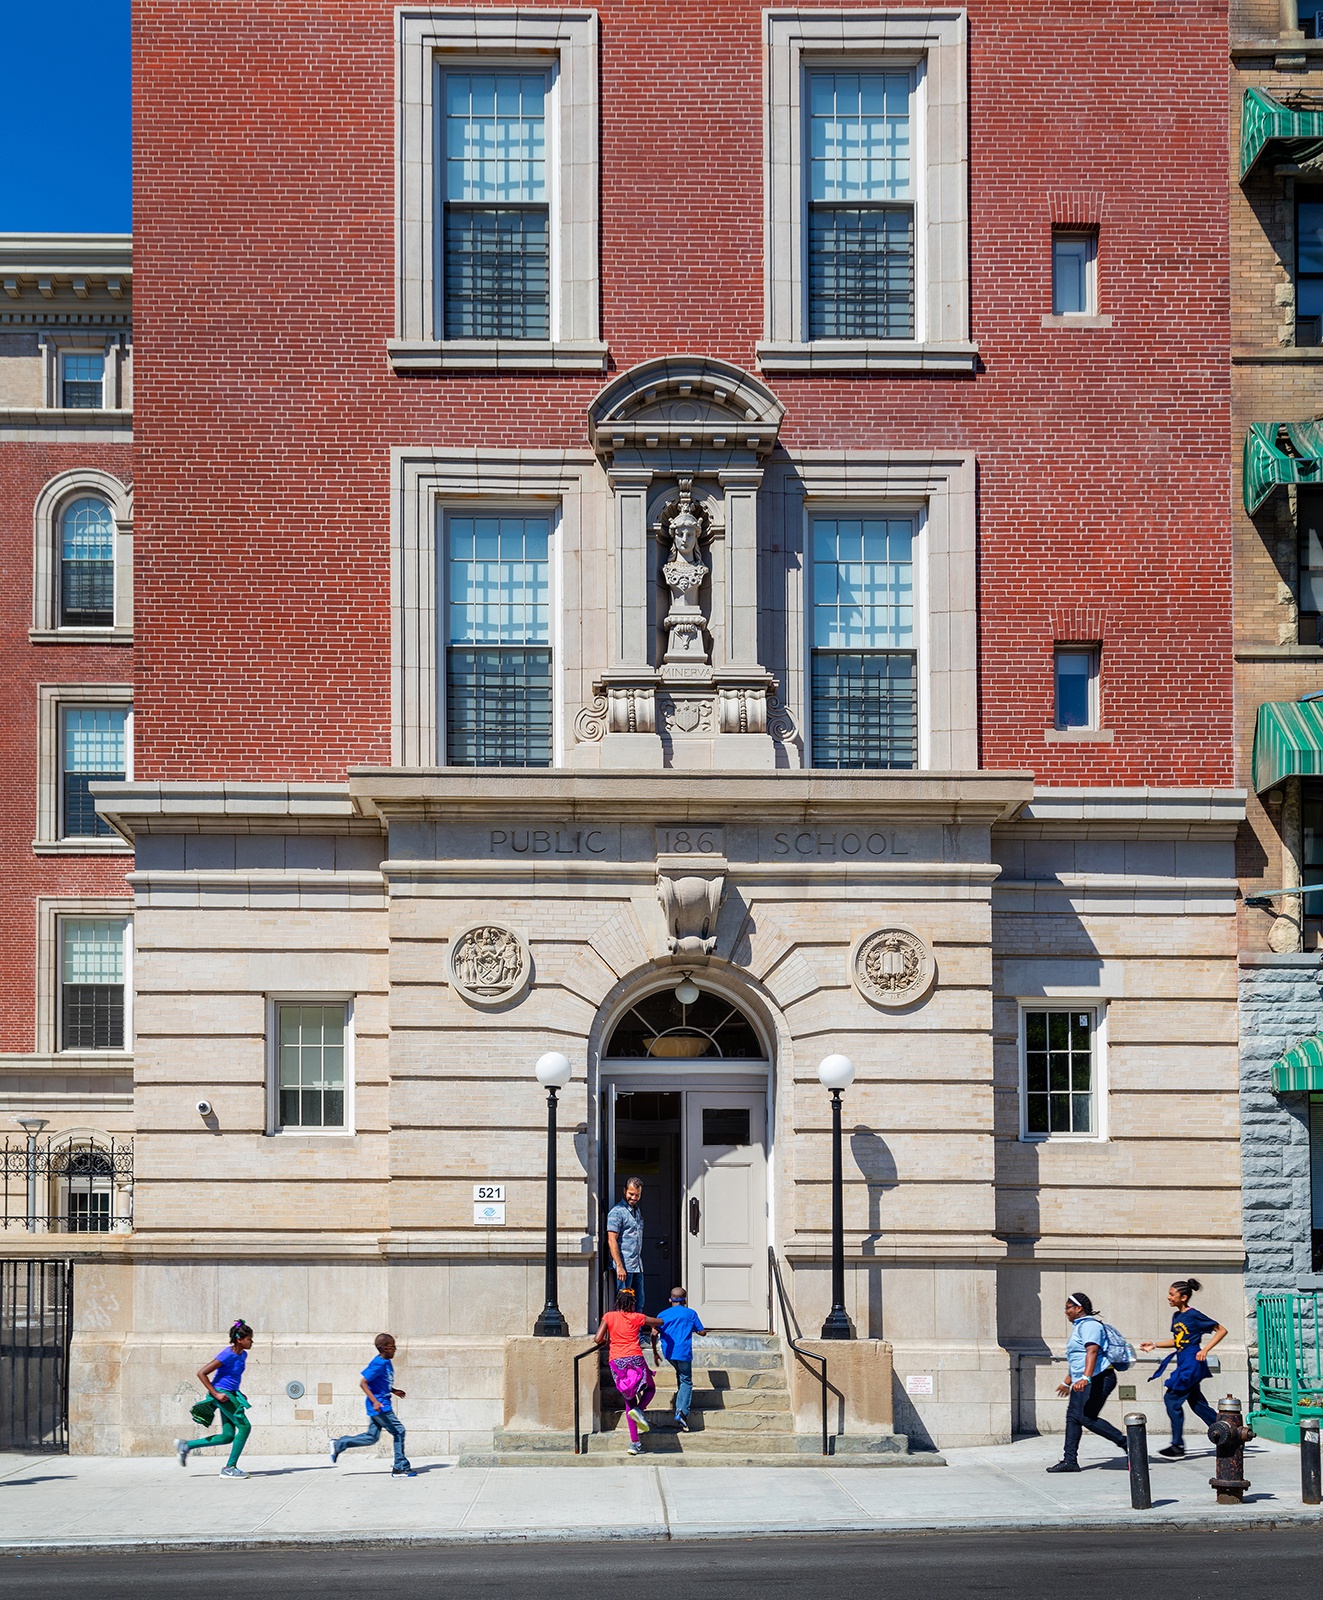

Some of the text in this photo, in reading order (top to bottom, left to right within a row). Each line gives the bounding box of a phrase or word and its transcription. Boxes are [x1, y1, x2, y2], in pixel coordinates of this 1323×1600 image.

[662, 668, 711, 678] MINERVA
[490, 831, 909, 855] PUBLIC 186 SCHOOL
[478, 1187, 500, 1198] 521
